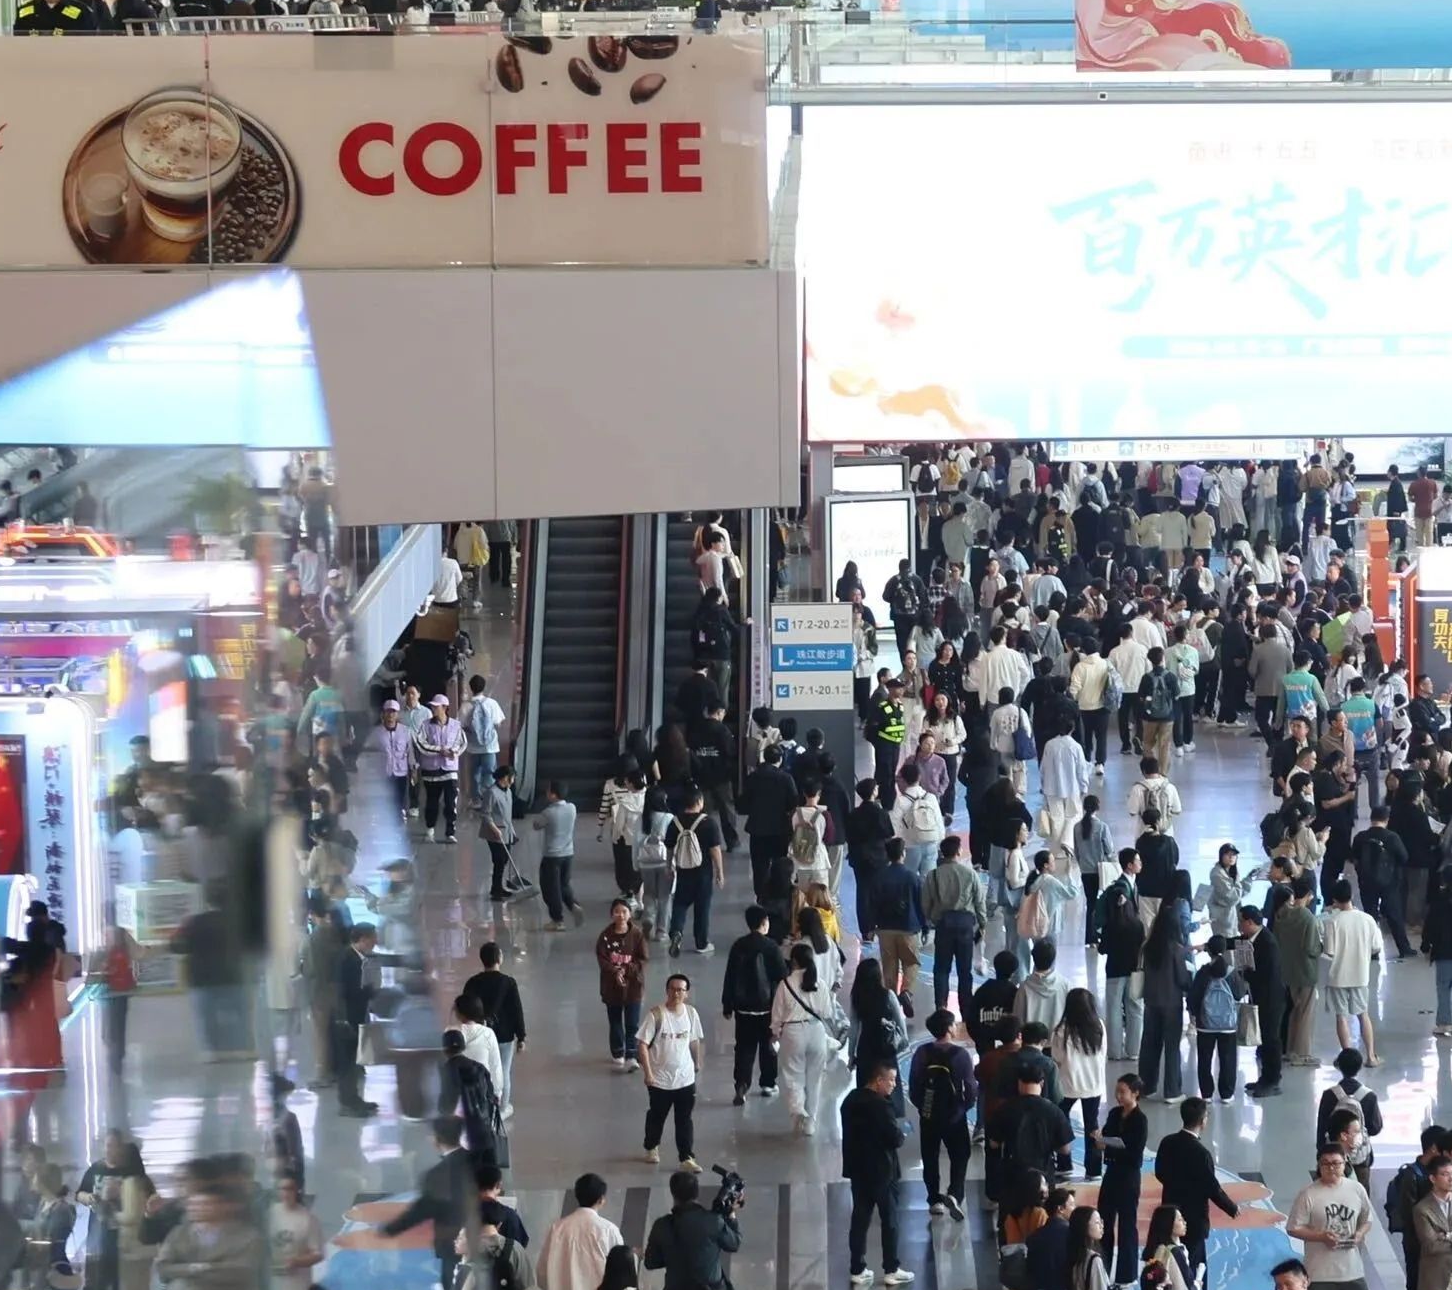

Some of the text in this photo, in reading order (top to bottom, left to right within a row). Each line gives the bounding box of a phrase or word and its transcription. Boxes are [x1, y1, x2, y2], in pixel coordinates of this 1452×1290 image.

[339, 121, 702, 196] COFFEE
[791, 619, 840, 630] 17.2-20.2
[796, 649, 846, 660] 珠江散步道
[792, 685, 841, 696] 17.1-20.1
